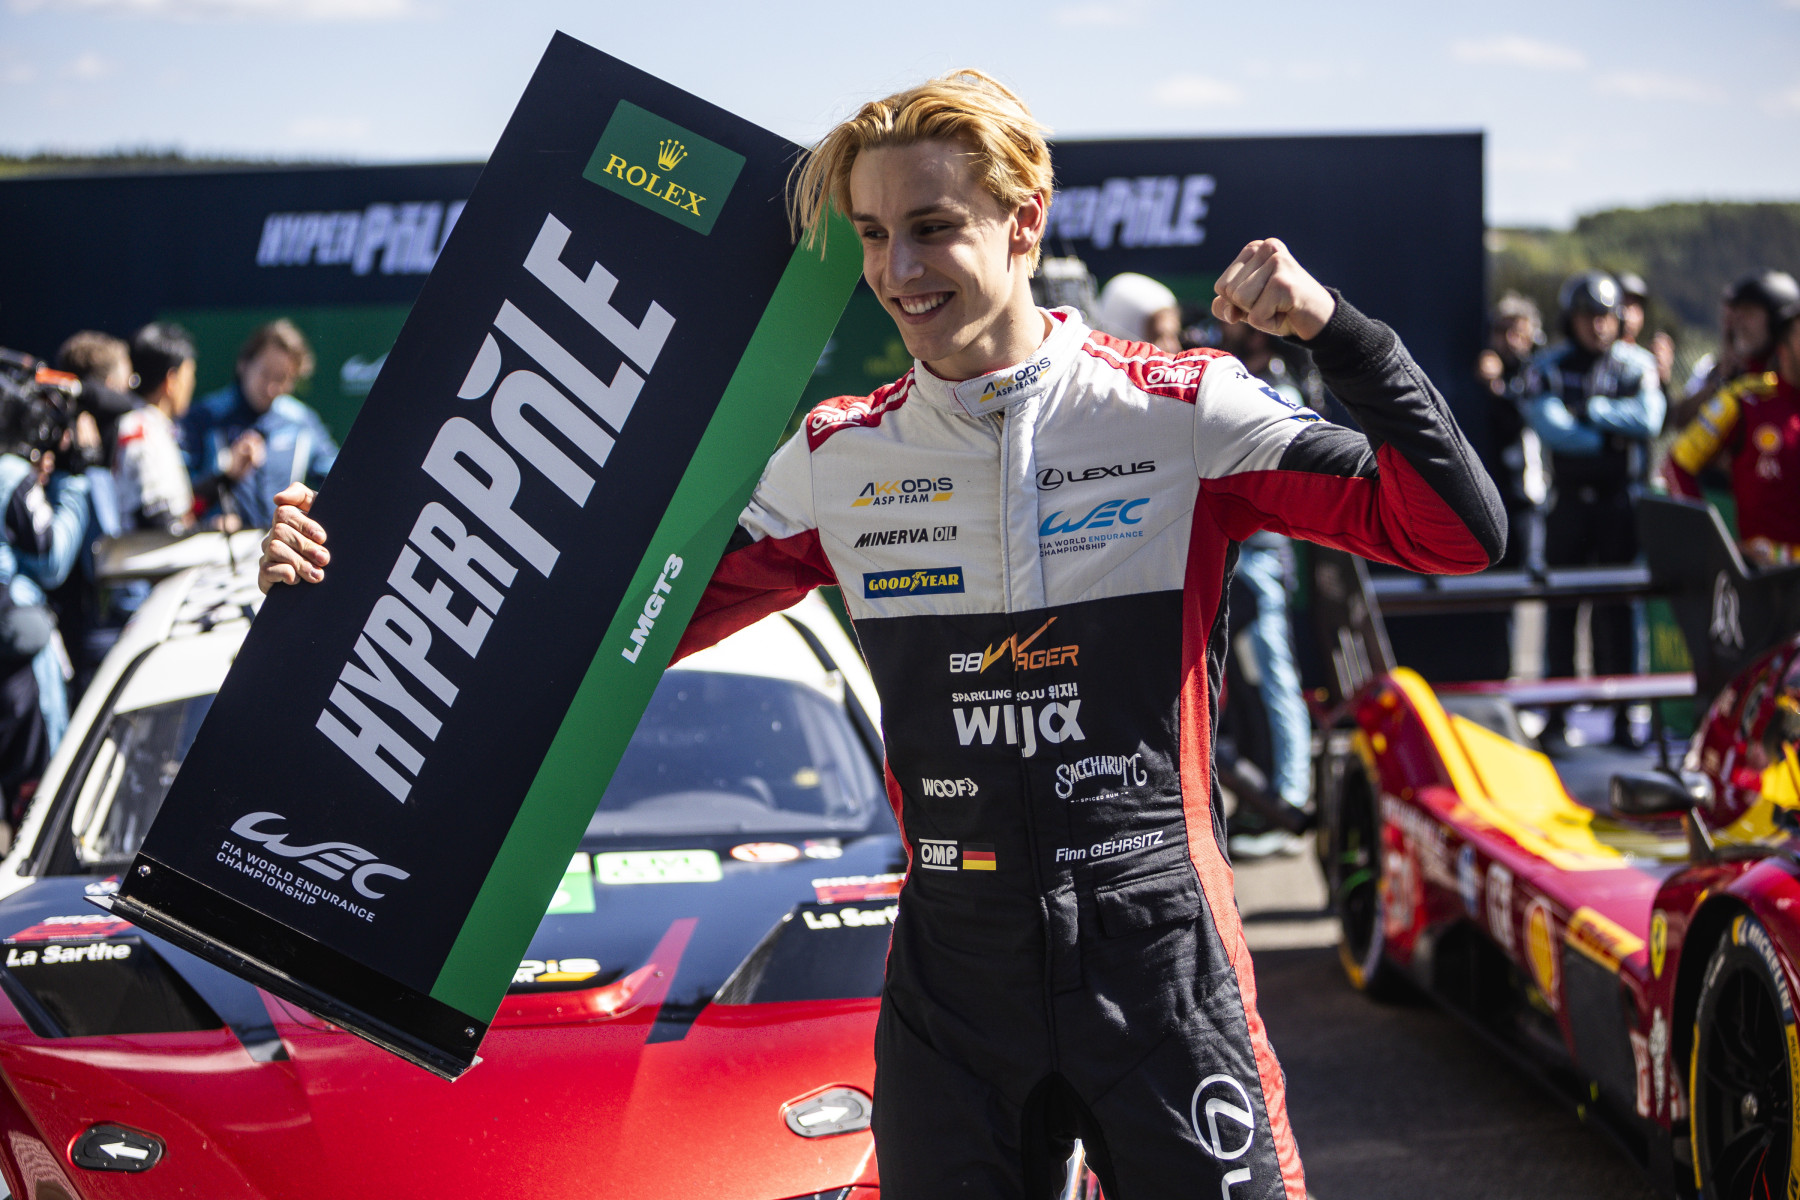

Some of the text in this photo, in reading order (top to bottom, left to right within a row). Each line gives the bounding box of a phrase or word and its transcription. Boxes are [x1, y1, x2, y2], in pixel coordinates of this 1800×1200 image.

[602, 153, 707, 217] ROLEX
[996, 375, 1038, 398] ASP TEAM
[1146, 368, 1200, 385] OMP
[1067, 460, 1156, 482] LEXUS
[872, 494, 929, 506] ASP TEAM
[1039, 497, 1151, 537] WEC
[854, 526, 957, 548] MINERVA OIL
[1040, 530, 1144, 550] FIA WORLD ENDURANCE
[1040, 542, 1107, 558] CHAMPIONSHIP
[621, 553, 684, 664] LMGT3
[951, 689, 1012, 703] SPARKLING
[1016, 688, 1045, 702] SOJU
[921, 777, 967, 798] WOOF
[230, 811, 411, 900] WEC
[921, 844, 958, 865] OMP
[1055, 830, 1164, 862] Finn GEHRSITZ
[215, 851, 317, 906] CHAMPIONSHIP
[220, 840, 376, 923] FIA WORLD ENDURANCE
[802, 911, 842, 930] La
[5, 942, 131, 968] La Sarthe
